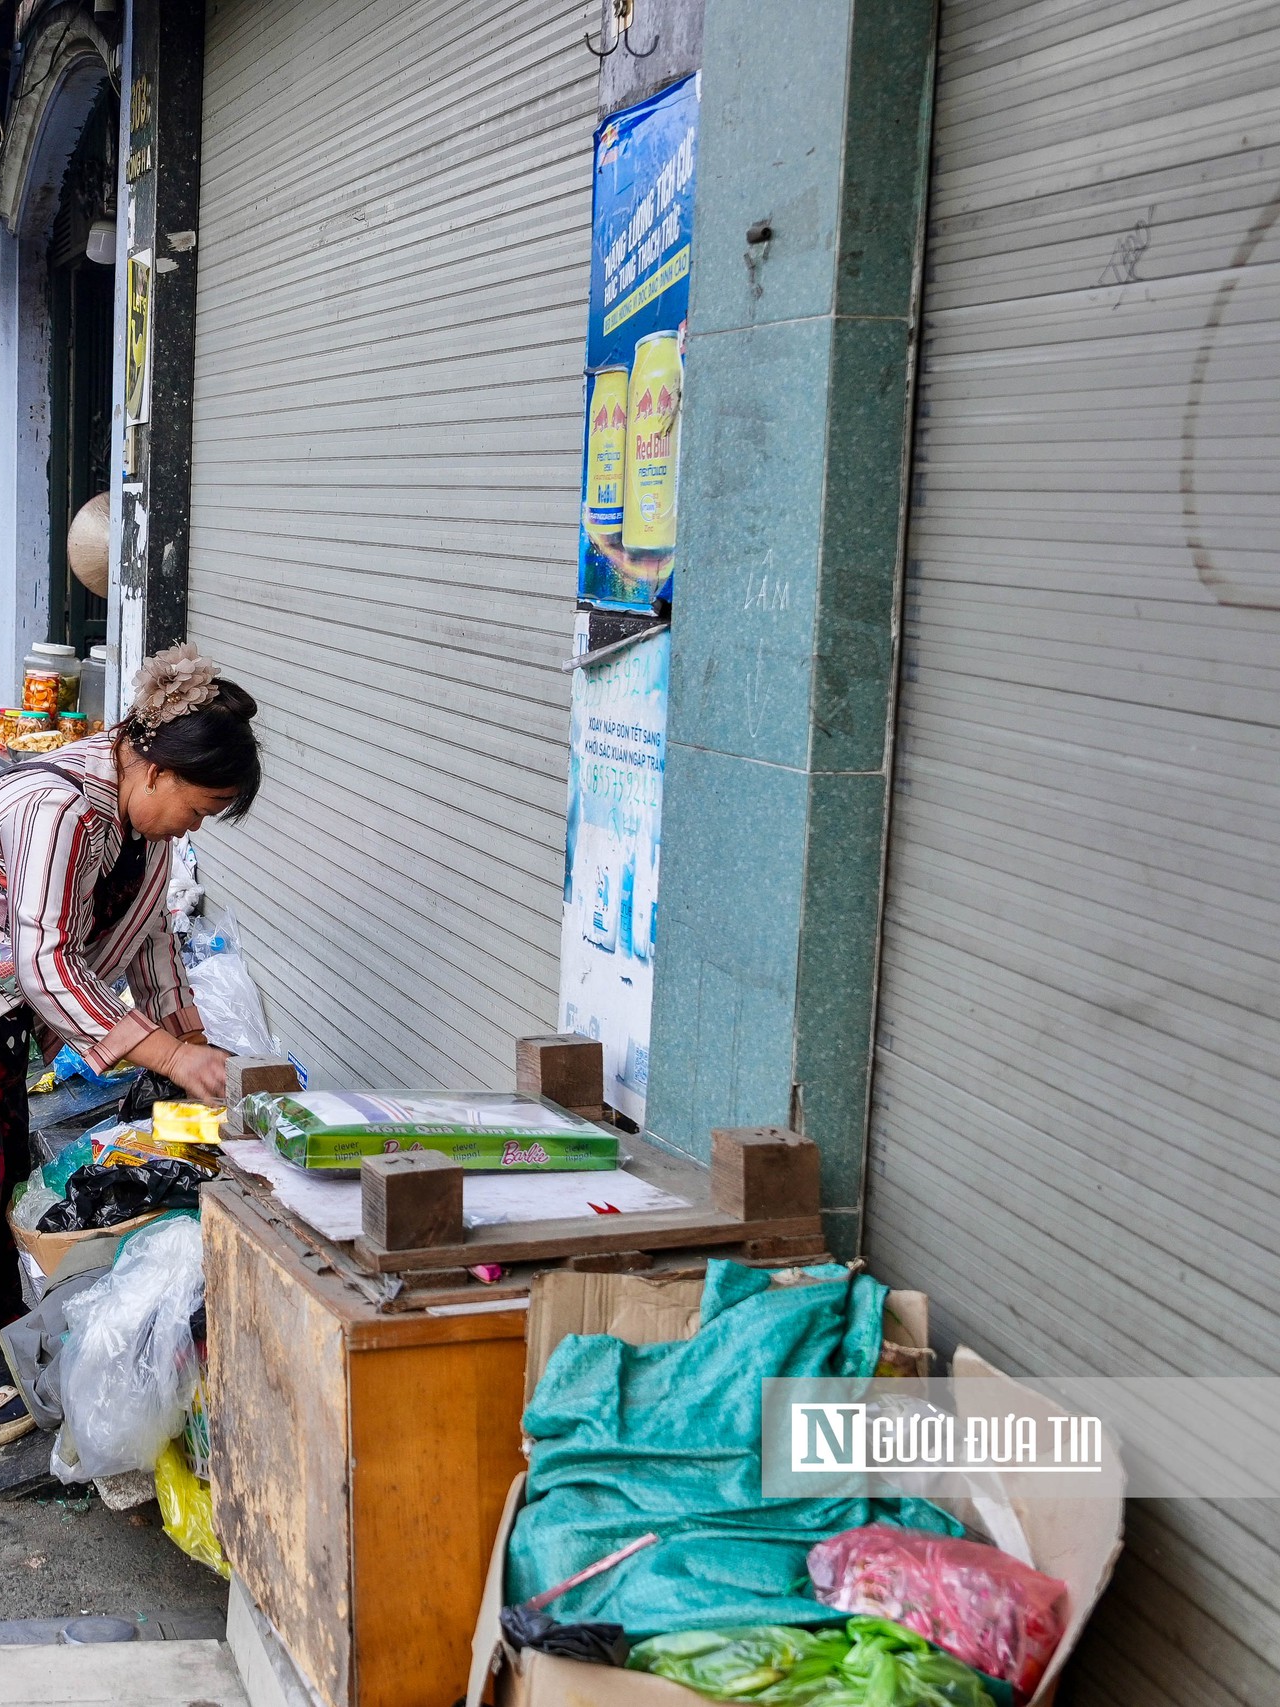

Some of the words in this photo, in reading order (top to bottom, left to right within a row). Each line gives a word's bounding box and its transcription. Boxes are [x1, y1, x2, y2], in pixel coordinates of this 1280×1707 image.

[636, 434, 652, 460] Red
[654, 431, 671, 458] Bull
[588, 716, 602, 732] XOAY
[643, 730, 661, 747] SANG
[334, 1141, 358, 1152] clever
[452, 1142, 477, 1153] clever
[501, 1139, 549, 1165] Barbie
[565, 1142, 589, 1152] clever
